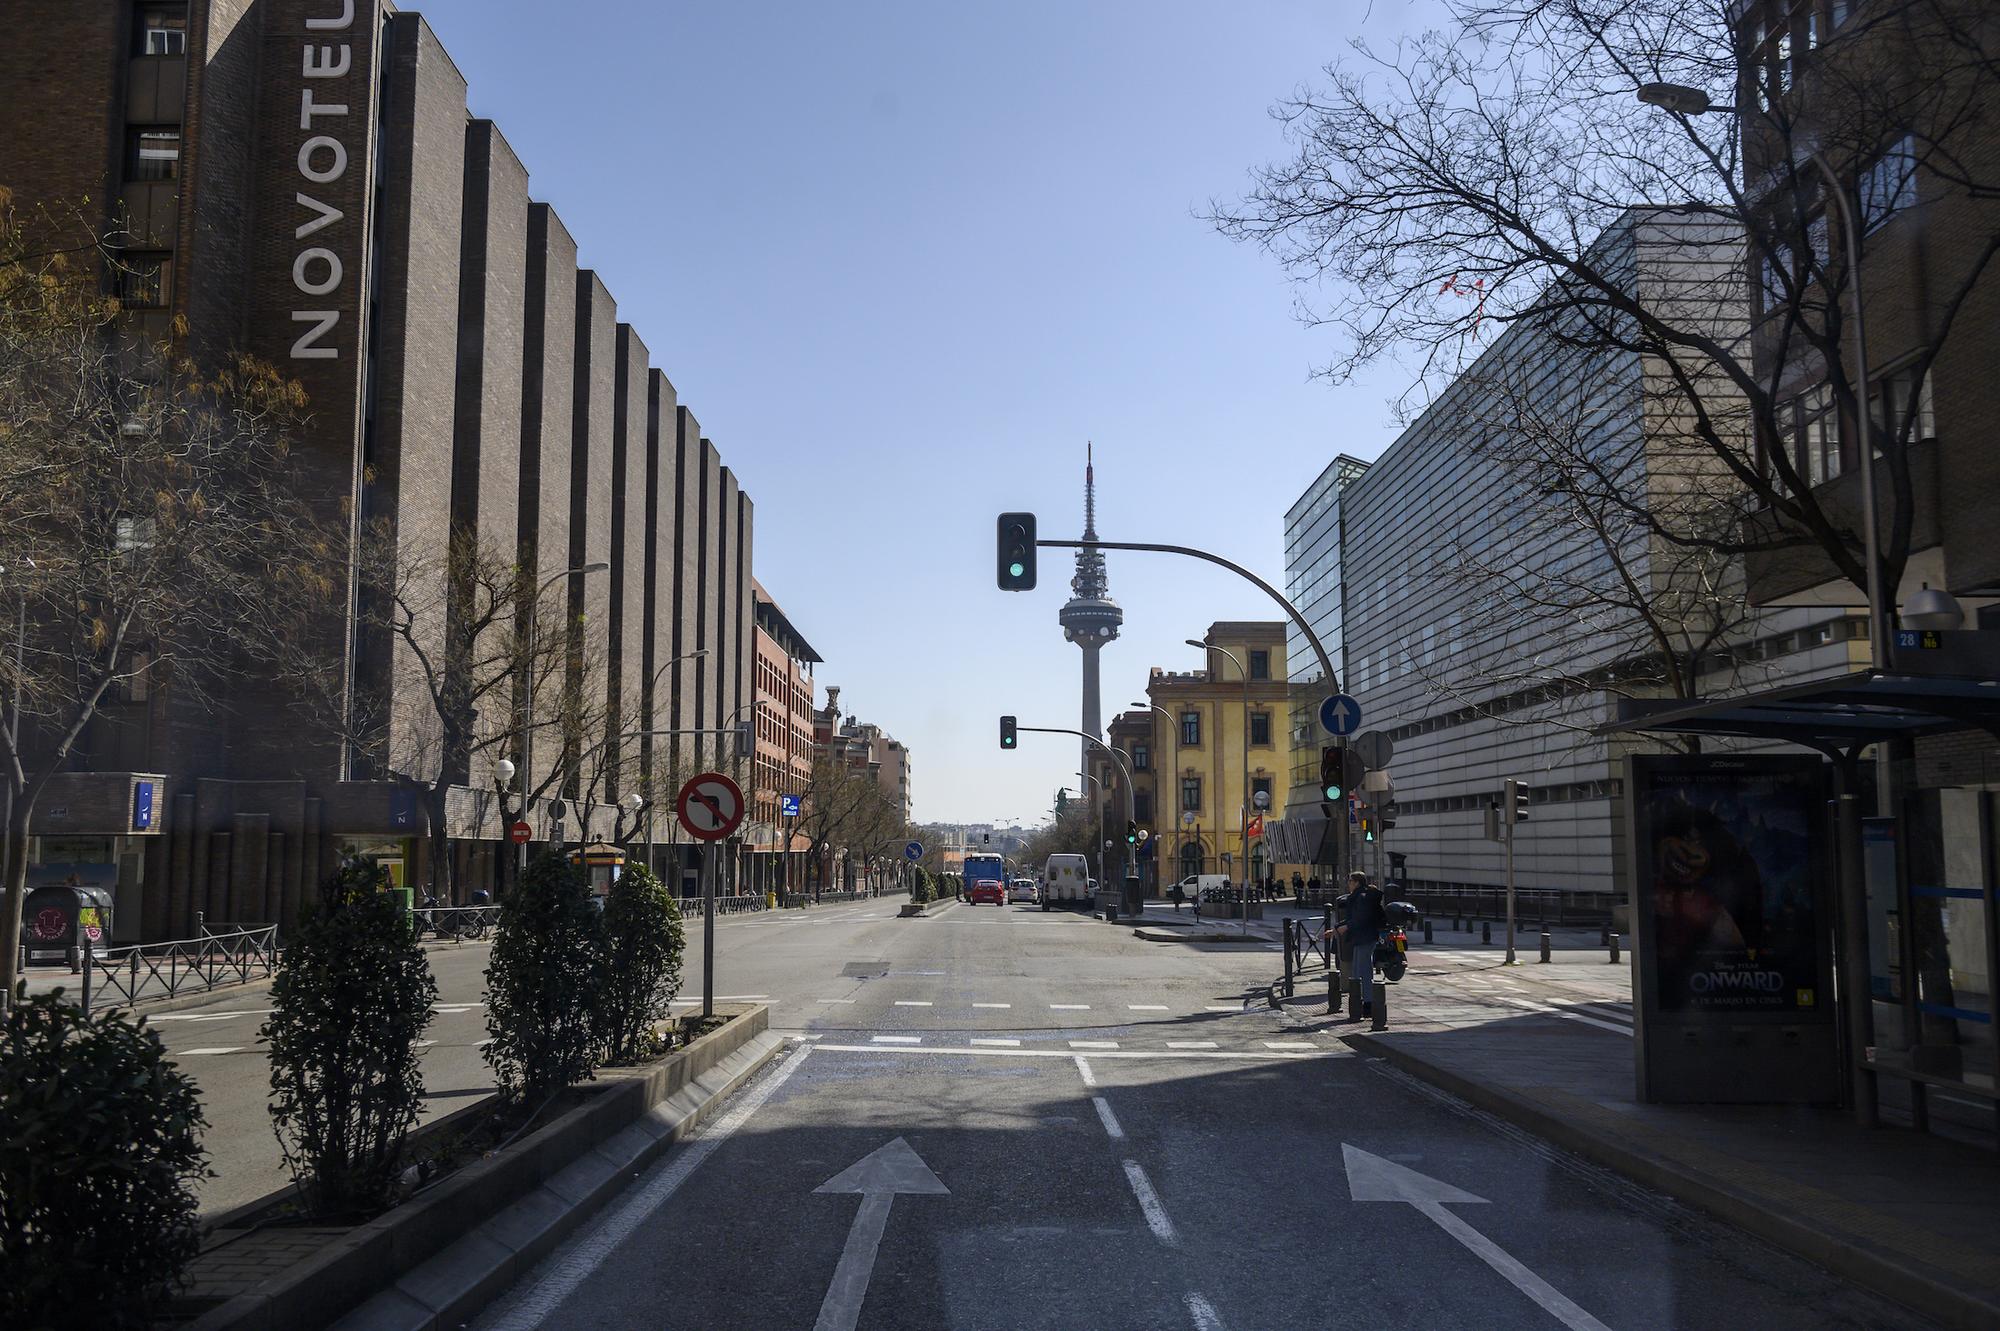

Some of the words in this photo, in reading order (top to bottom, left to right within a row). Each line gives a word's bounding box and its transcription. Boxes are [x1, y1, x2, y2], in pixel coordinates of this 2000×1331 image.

[290, 0, 355, 358] NOVOTEL
[1900, 633, 1916, 646] 28
[1923, 637, 1937, 649] N6
[783, 797, 791, 808] P
[1689, 971, 1784, 993] ONWARD
